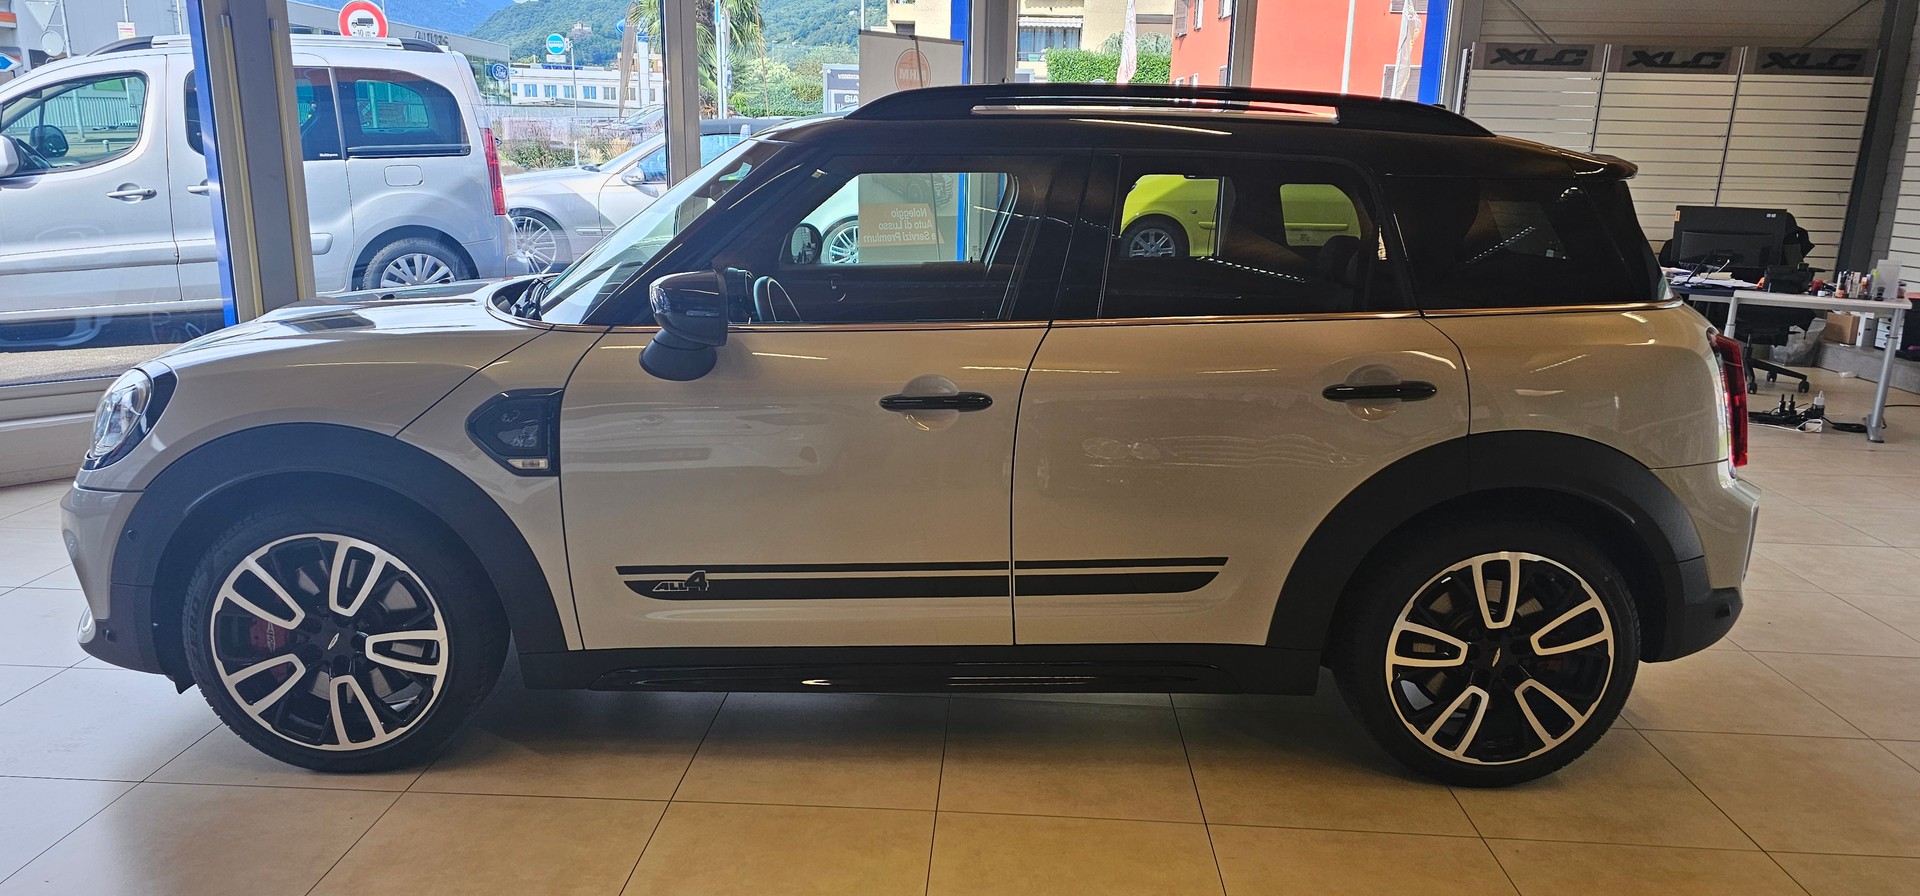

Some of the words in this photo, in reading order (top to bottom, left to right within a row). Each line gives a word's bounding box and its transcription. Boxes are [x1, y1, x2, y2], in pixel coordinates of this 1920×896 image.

[1490, 47, 1587, 65] XLC
[1627, 50, 1726, 68] XLC
[1762, 51, 1863, 70] XLC
